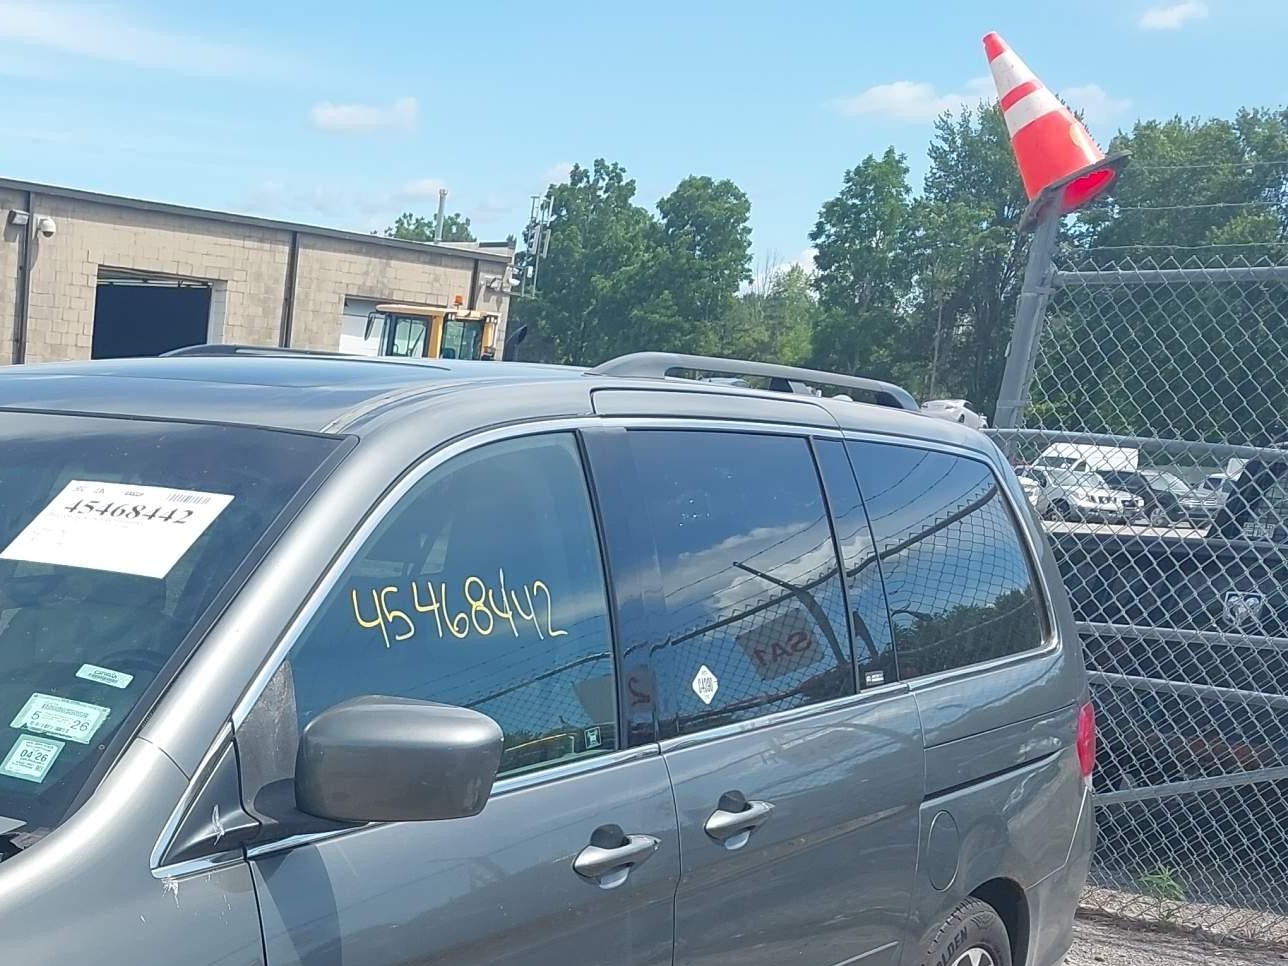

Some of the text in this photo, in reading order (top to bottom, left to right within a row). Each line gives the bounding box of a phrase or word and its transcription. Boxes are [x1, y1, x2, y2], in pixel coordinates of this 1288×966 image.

[64, 499, 194, 524] 45468442
[352, 568, 568, 648] 45468442
[69, 719, 90, 732] 26
[19, 749, 49, 762] 04 26
